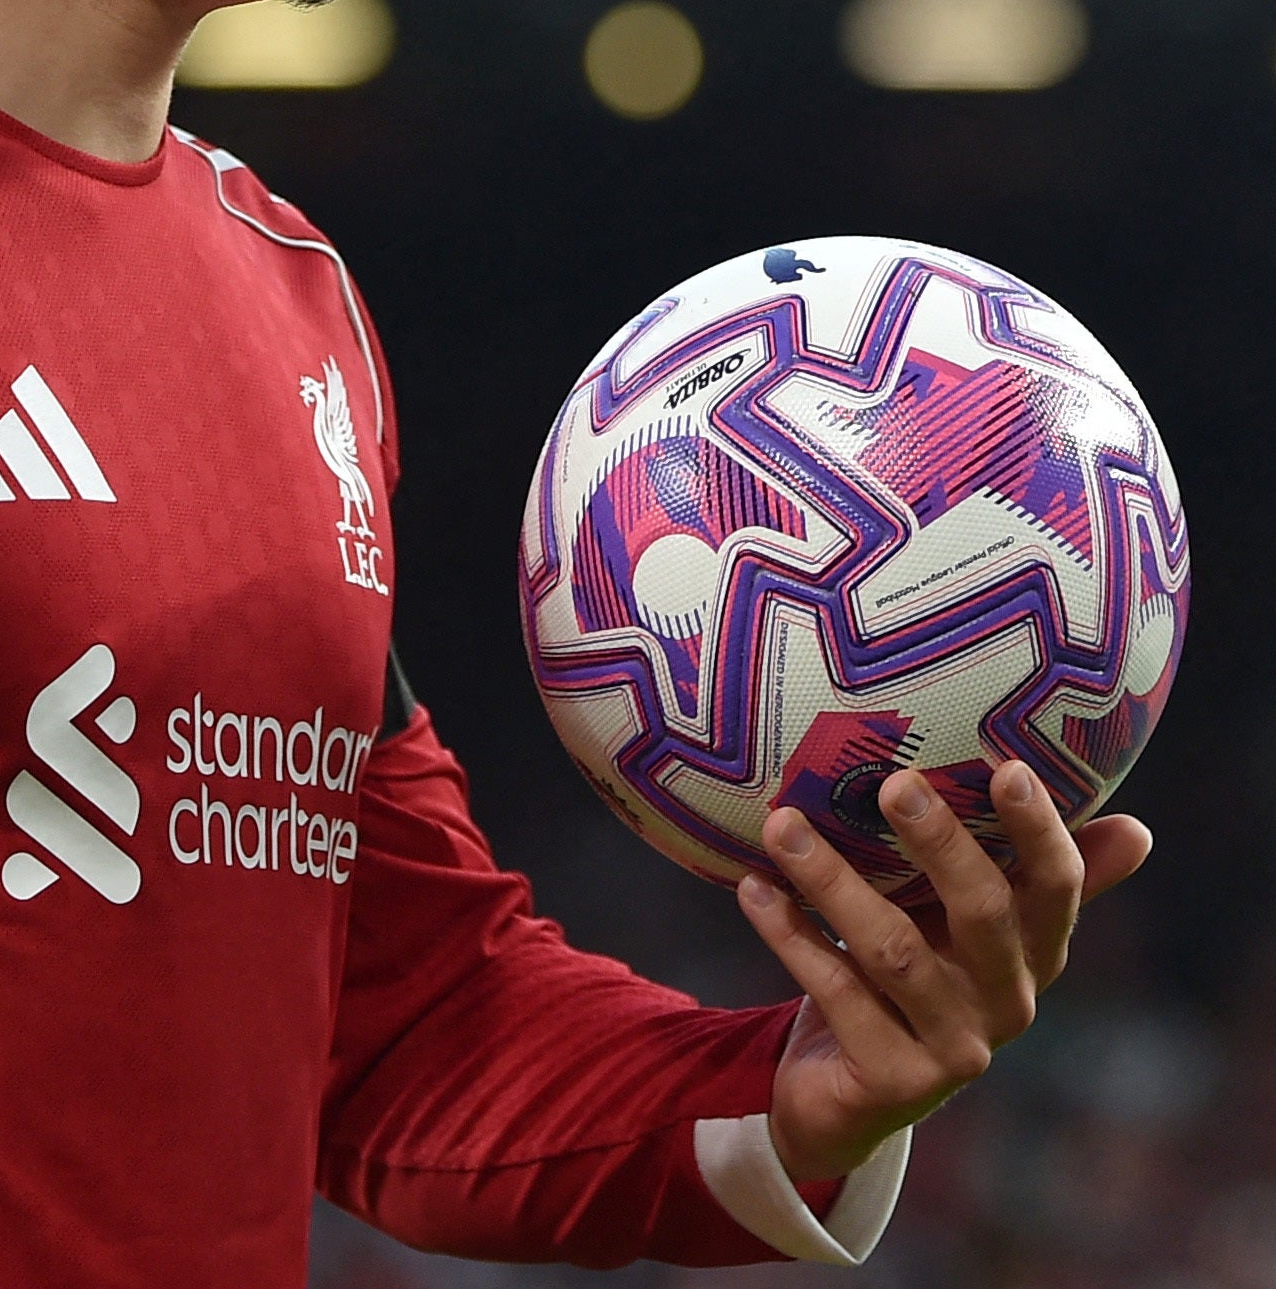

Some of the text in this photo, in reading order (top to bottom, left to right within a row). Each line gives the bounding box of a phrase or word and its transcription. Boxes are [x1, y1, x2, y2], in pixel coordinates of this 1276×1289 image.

[663, 349, 751, 409] ORBITA
[666, 363, 707, 392] ULTIMATE
[987, 536, 1015, 556] Official
[955, 551, 987, 571] Premier
[921, 567, 954, 587] League
[777, 622, 789, 674] DESIGNED
[776, 676, 784, 687] IN
[166, 691, 379, 794] standar
[168, 782, 358, 884] chartere
